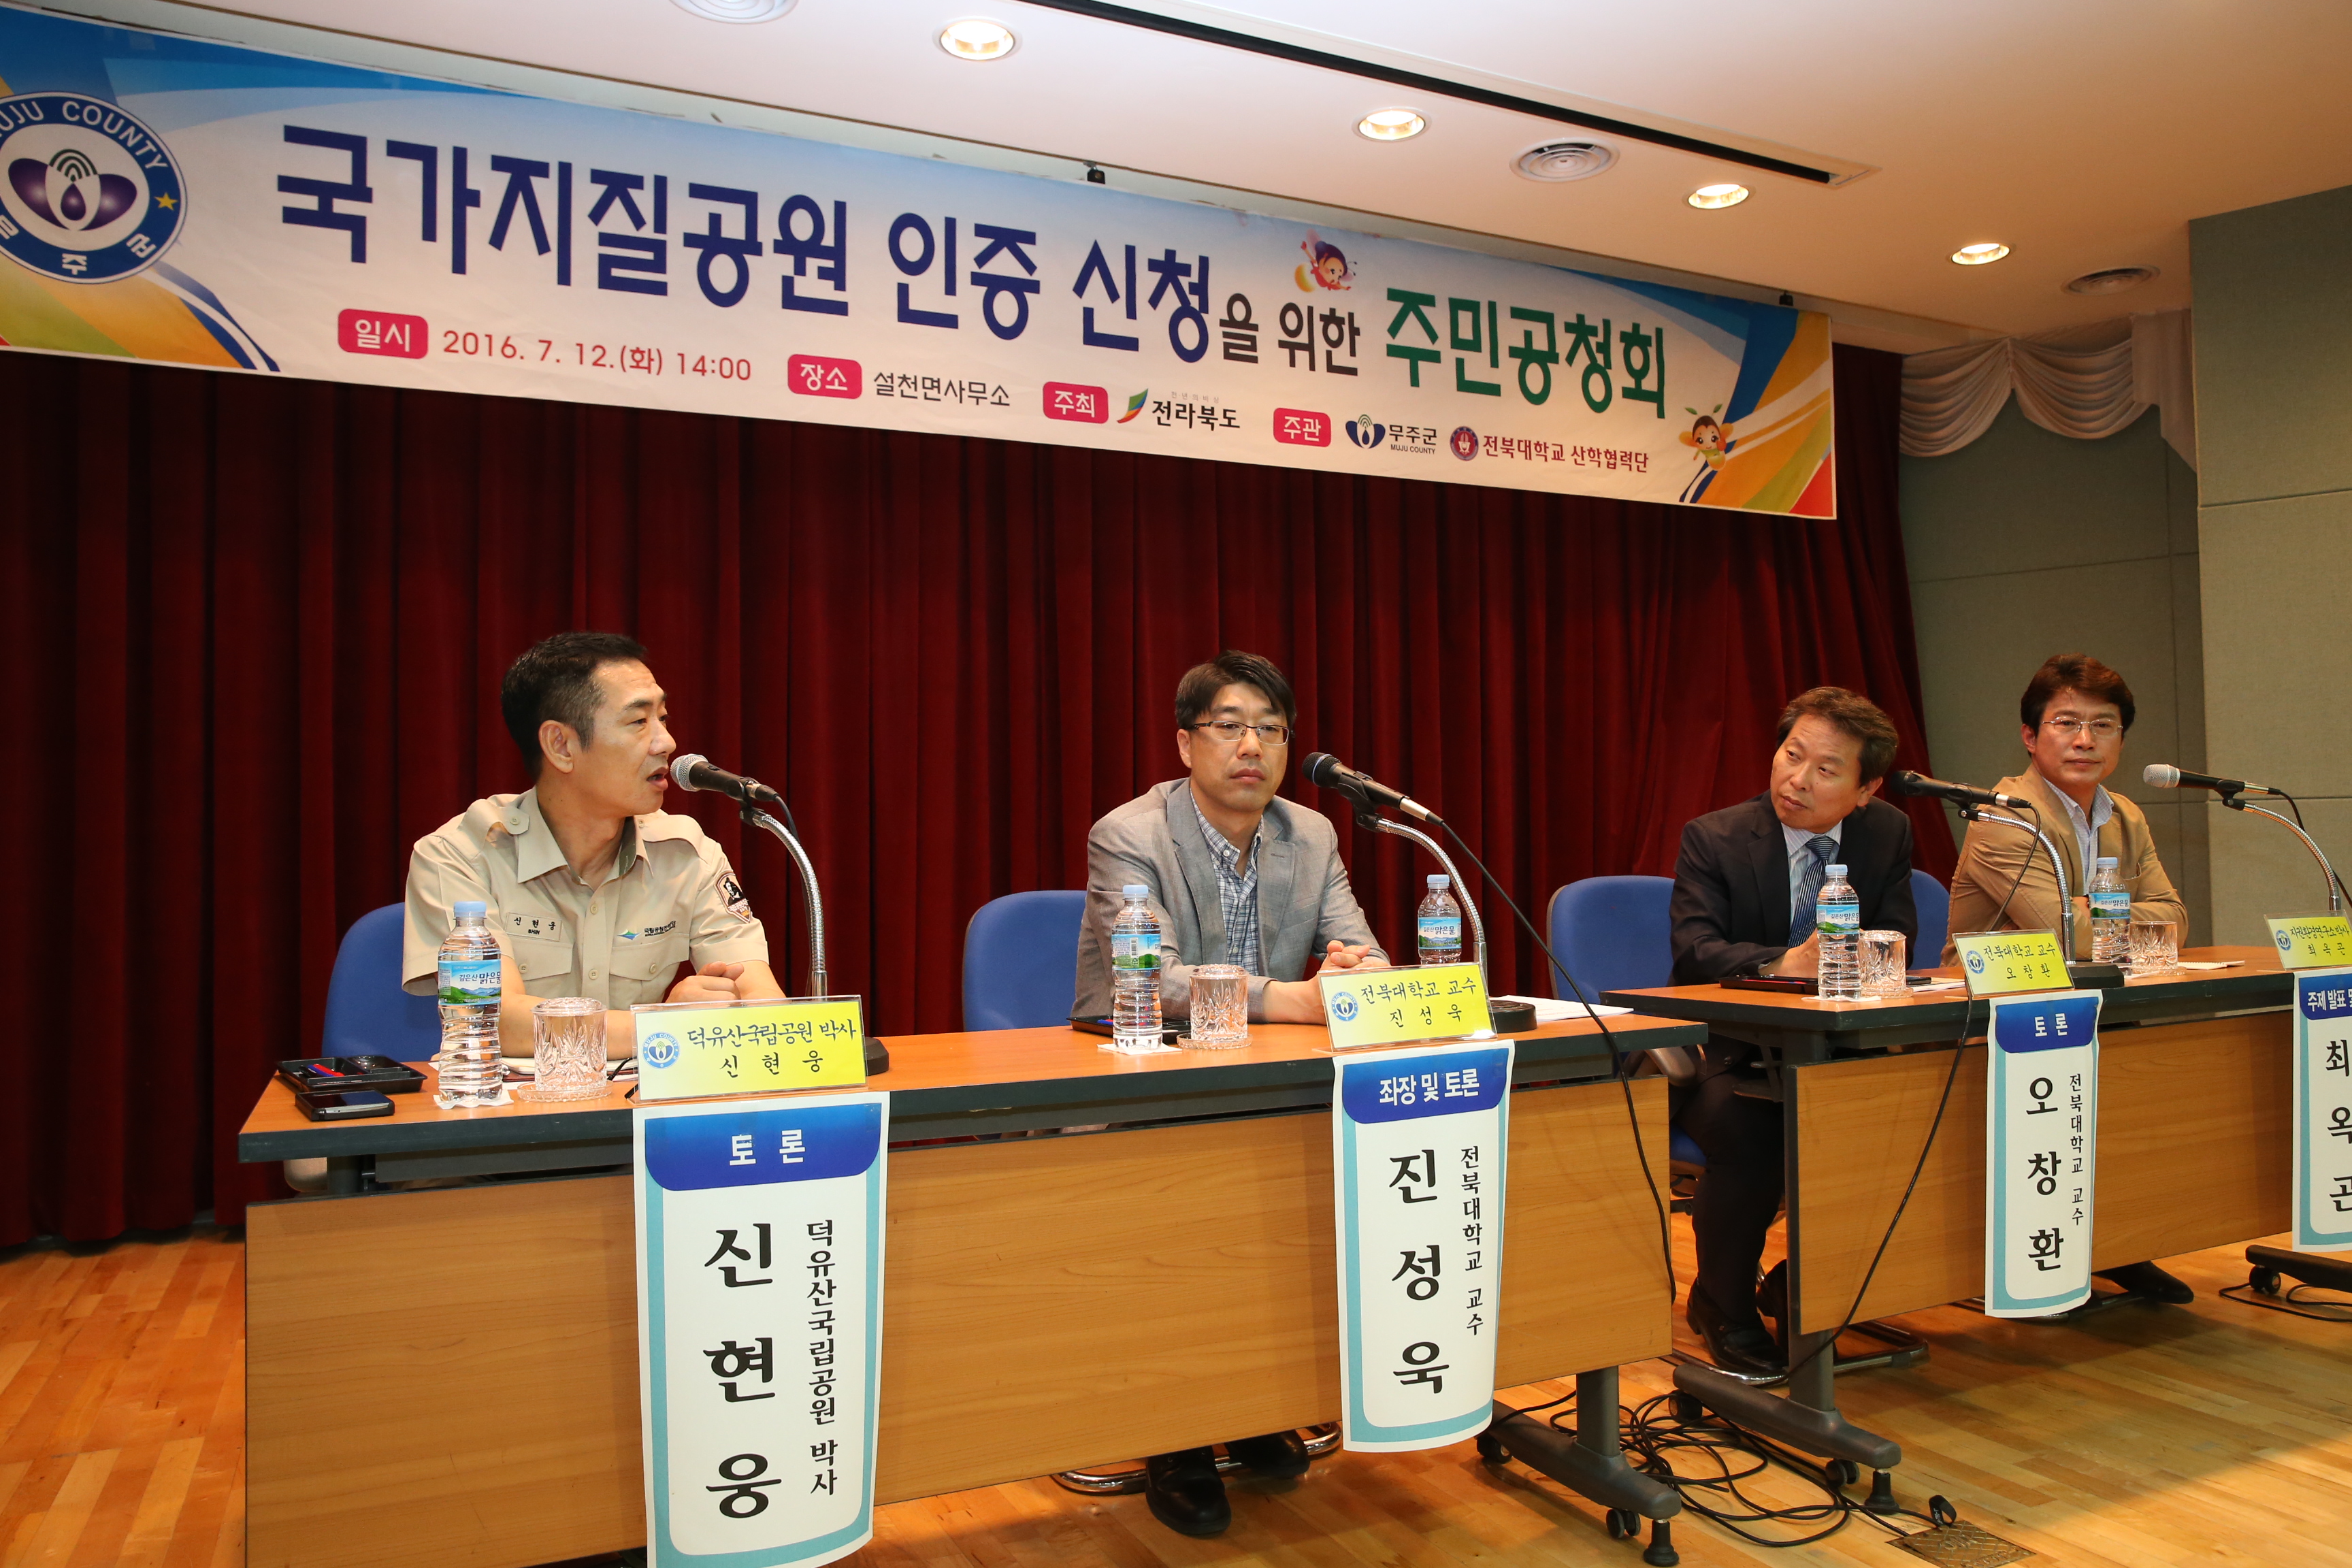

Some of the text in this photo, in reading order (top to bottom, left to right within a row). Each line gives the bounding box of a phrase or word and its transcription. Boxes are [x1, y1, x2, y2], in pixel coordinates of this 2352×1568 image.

[0, 101, 169, 169] UJU COUNTY
[278, 125, 1665, 419] 국가지질공원 인증 신청을 위한 주민공청회
[355, 319, 411, 353] 일시
[443, 330, 525, 361] 2016.
[538, 341, 561, 363] 7.
[676, 353, 751, 381] 14:00
[800, 363, 849, 392] 장소
[873, 372, 1011, 408] 설천면사무소
[1054, 390, 1097, 418] 주최
[1152, 401, 1241, 431] 전라북도
[1283, 414, 1322, 442] 주관
[1389, 424, 1437, 446] 무주군
[1390, 444, 1436, 455] MUJU COUNTY
[1483, 436, 1565, 462] 전북대학교
[1571, 445, 1649, 473] 산학협력단
[1983, 943, 2056, 961] 전북대학교 교수
[1360, 977, 1477, 1004] 전북대학교 교수
[2308, 990, 2326, 1012] 주제
[2328, 990, 2347, 1010] 발표
[687, 1019, 857, 1049] 덕유산국립공원 박사
[1379, 1068, 1480, 1106] 좌장 및 토론
[2070, 1073, 2084, 1226] 전북대학교 교수
[1460, 1145, 1484, 1335] 전북대학교 교수
[806, 1220, 838, 1495] 덕유산국립공원 박사
